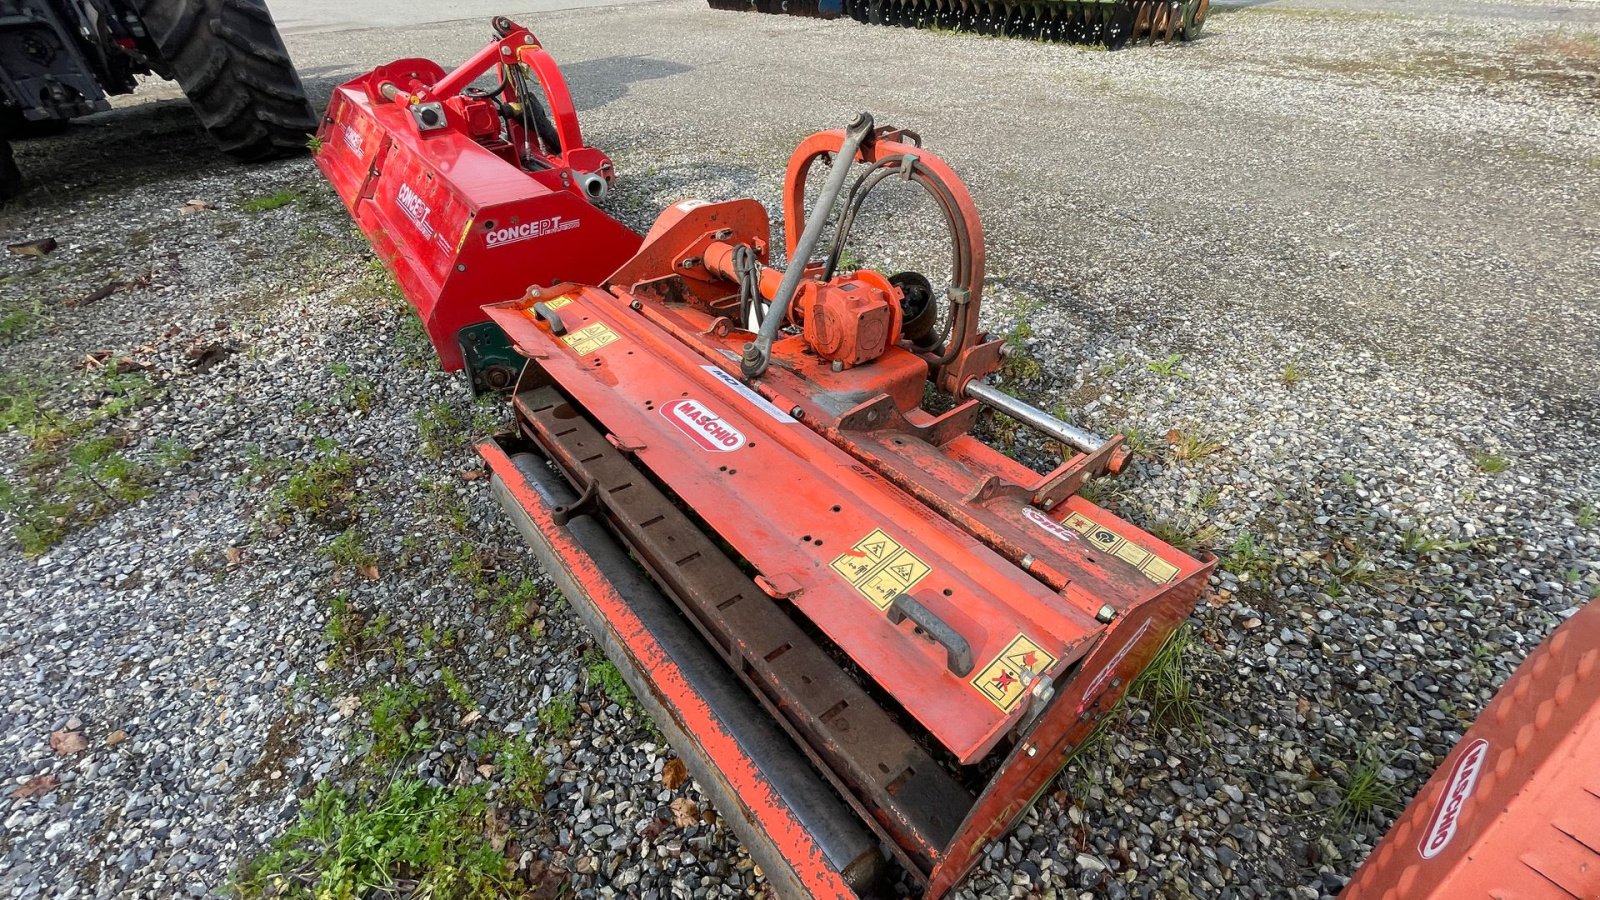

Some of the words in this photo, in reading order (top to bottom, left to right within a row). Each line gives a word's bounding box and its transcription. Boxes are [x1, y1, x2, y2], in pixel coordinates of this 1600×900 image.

[398, 182, 431, 223] CONCEPT
[486, 216, 562, 244] CONCEPT
[678, 402, 739, 447] MASCHIO
[1430, 747, 1482, 850] MASCHIO
